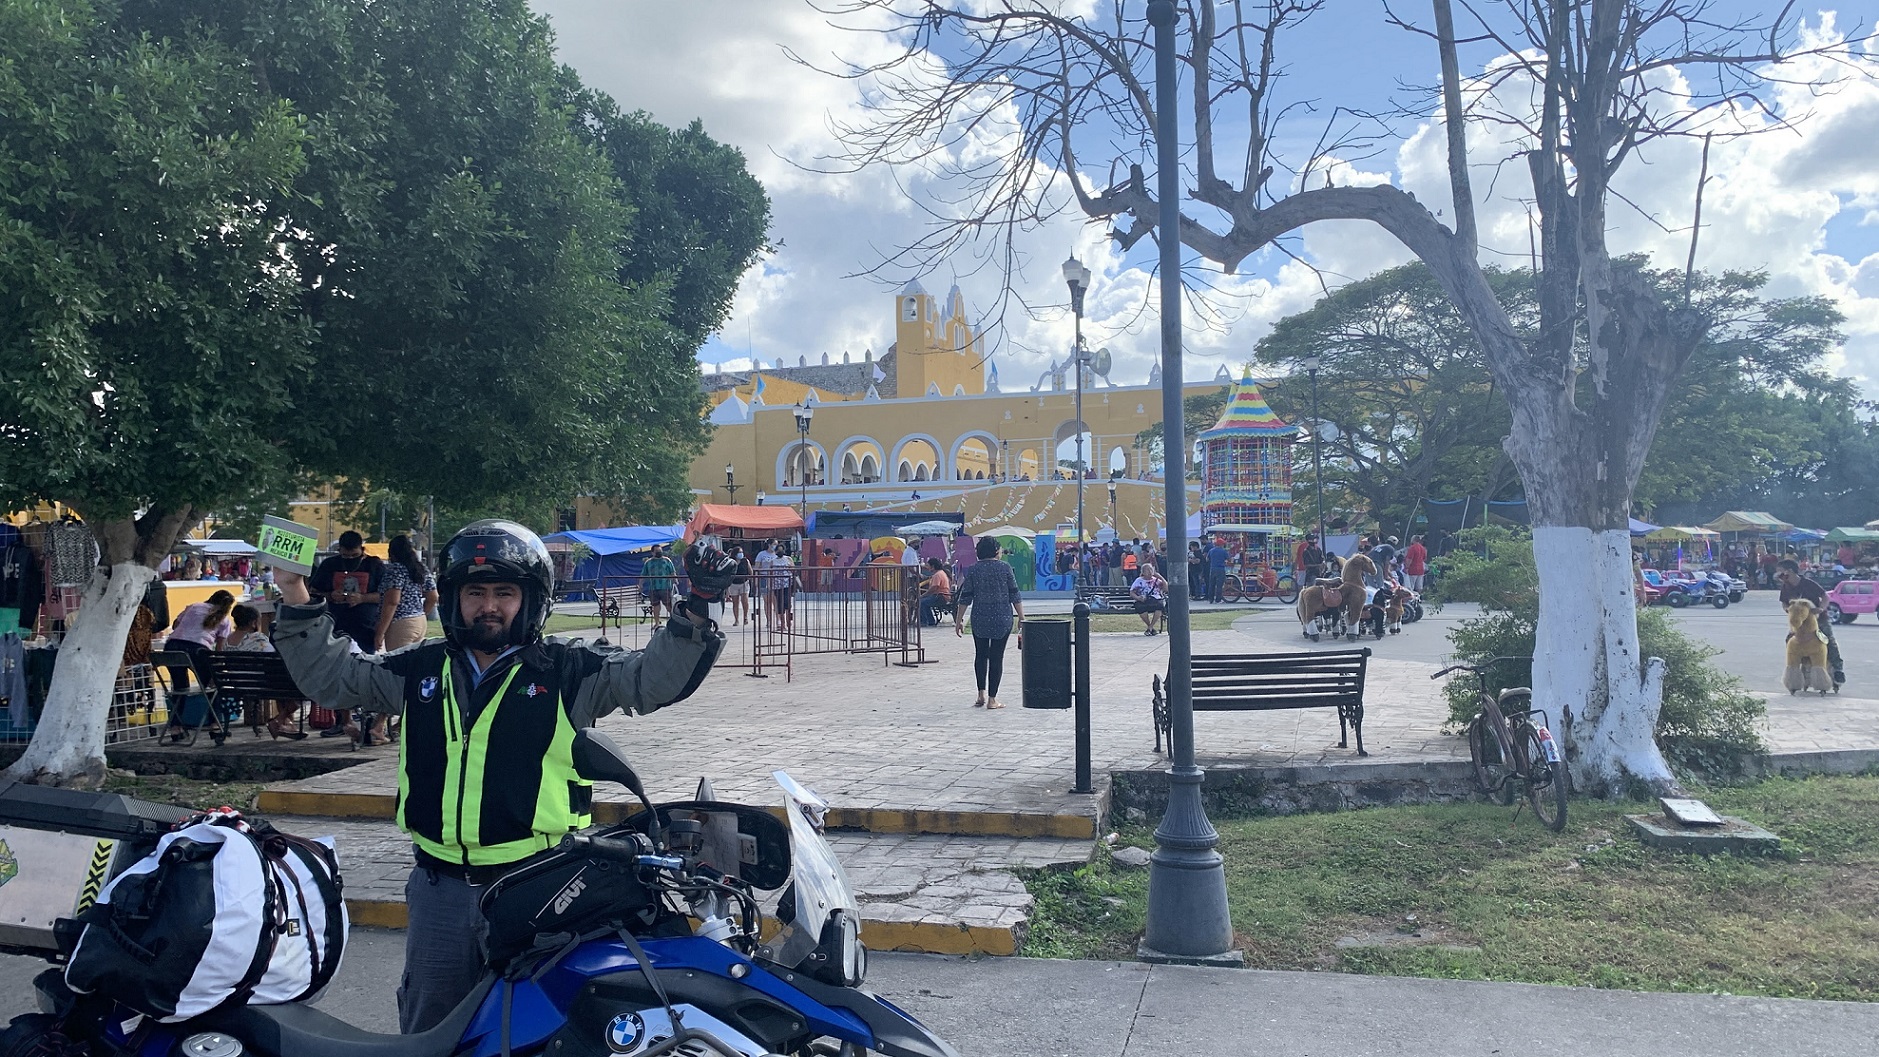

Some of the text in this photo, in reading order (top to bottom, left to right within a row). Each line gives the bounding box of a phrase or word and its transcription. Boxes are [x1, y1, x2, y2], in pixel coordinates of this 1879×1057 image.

[272, 535, 304, 555] RRM
[554, 878, 587, 915] GIVI
[613, 1014, 643, 1031] BMW
